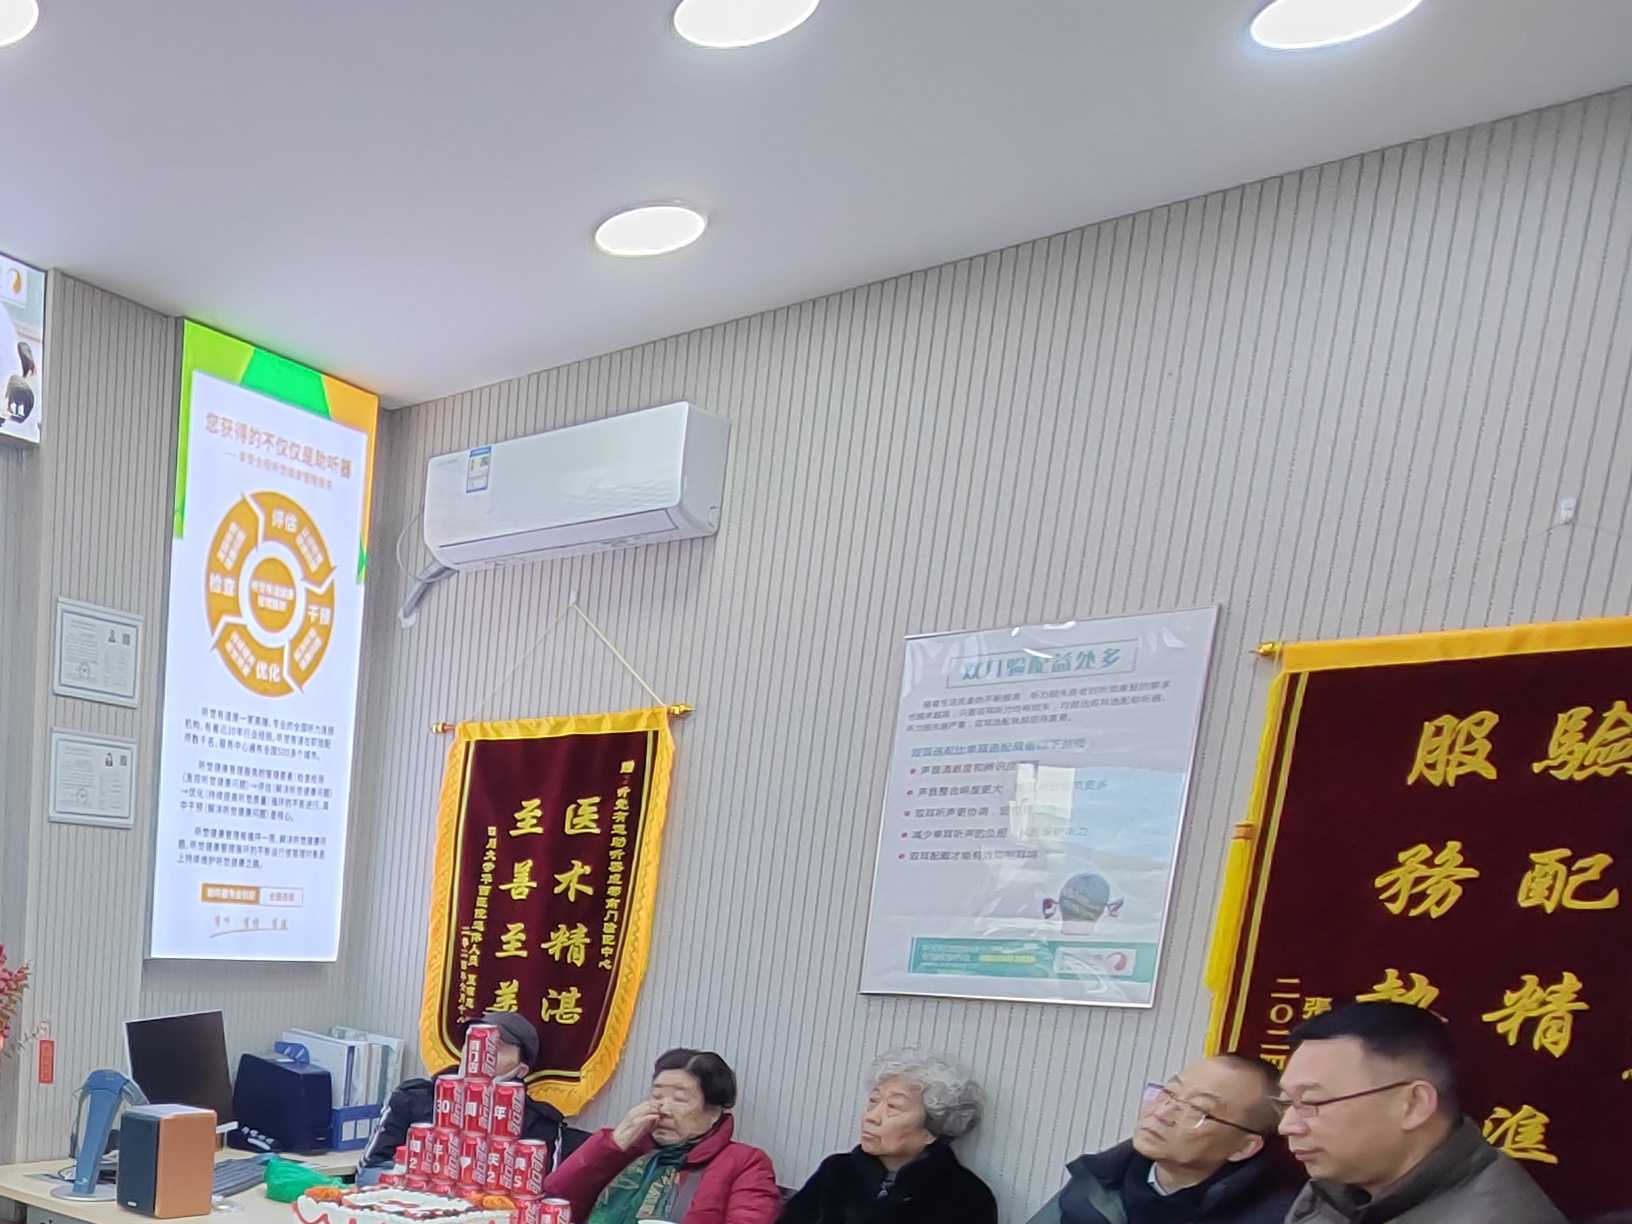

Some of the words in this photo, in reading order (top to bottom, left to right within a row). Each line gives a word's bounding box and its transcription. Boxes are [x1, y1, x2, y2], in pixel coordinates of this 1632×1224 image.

[482, 798, 544, 1014] 至善至美
[540, 796, 602, 1025] 医术精湛
[409, 1157, 418, 1169] 2
[487, 1171, 497, 1183] 2
[513, 1175, 523, 1188] 5
